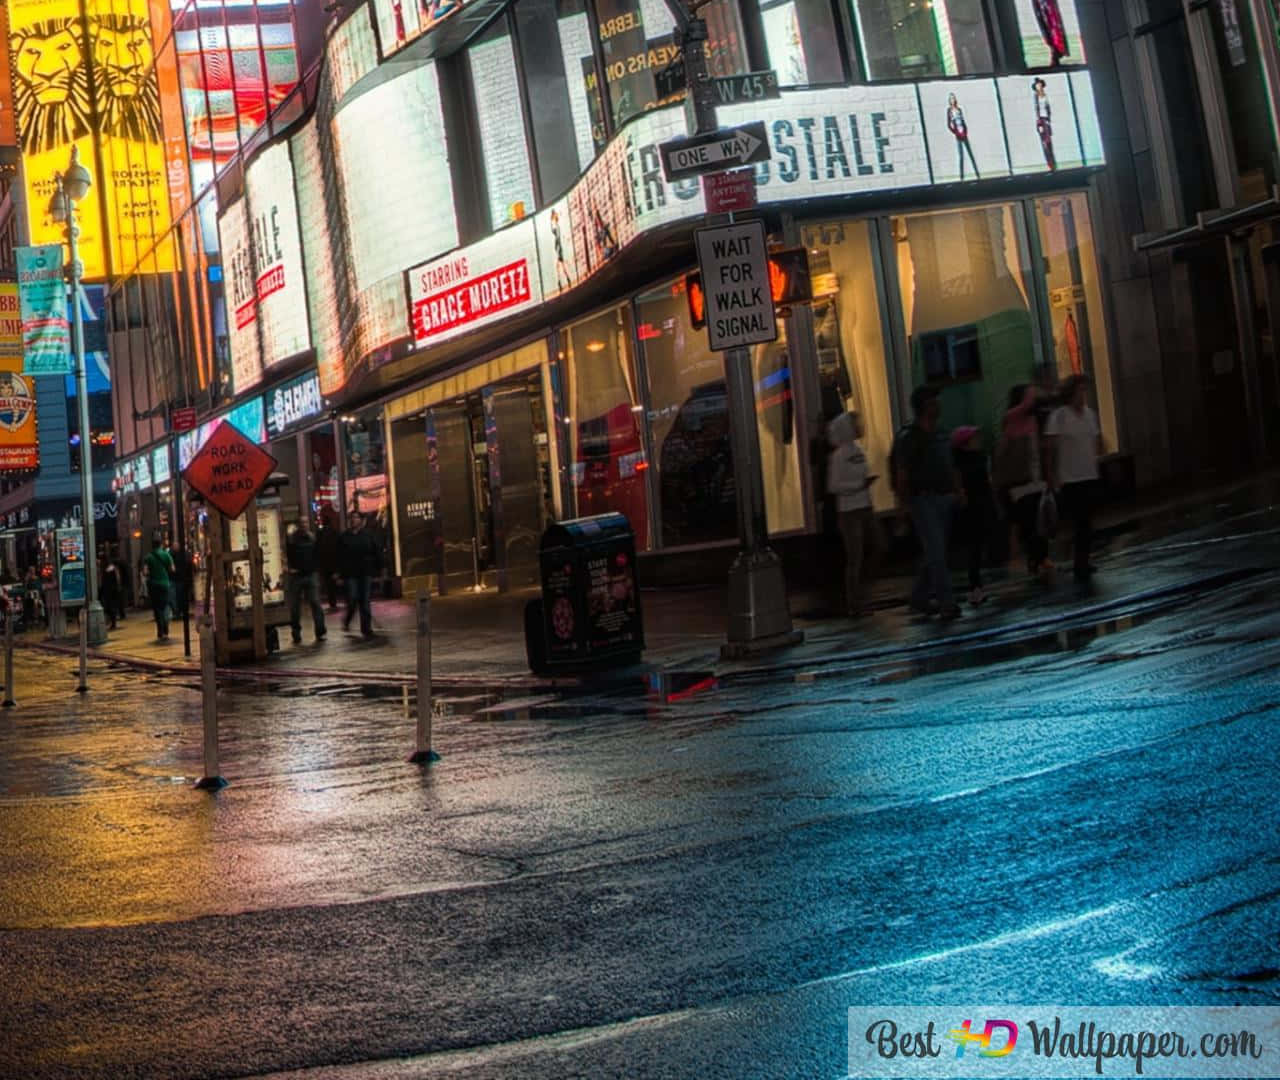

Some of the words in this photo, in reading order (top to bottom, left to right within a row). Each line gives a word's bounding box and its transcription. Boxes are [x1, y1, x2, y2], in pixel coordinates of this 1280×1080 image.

[717, 81, 737, 103] W
[741, 79, 764, 99] 45
[677, 146, 709, 167] ONE
[720, 137, 752, 157] WAY
[712, 236, 752, 259] WAIT
[421, 257, 469, 293] STARRING
[720, 265, 753, 285] FOR
[421, 291, 467, 331] GRACE
[468, 265, 527, 313] MORETZ
[715, 292, 763, 312] WALK
[716, 314, 769, 338] SIGNAL
[211, 443, 246, 457] ROAD
[212, 459, 246, 474] WORK
[211, 479, 255, 494] AHEAD
